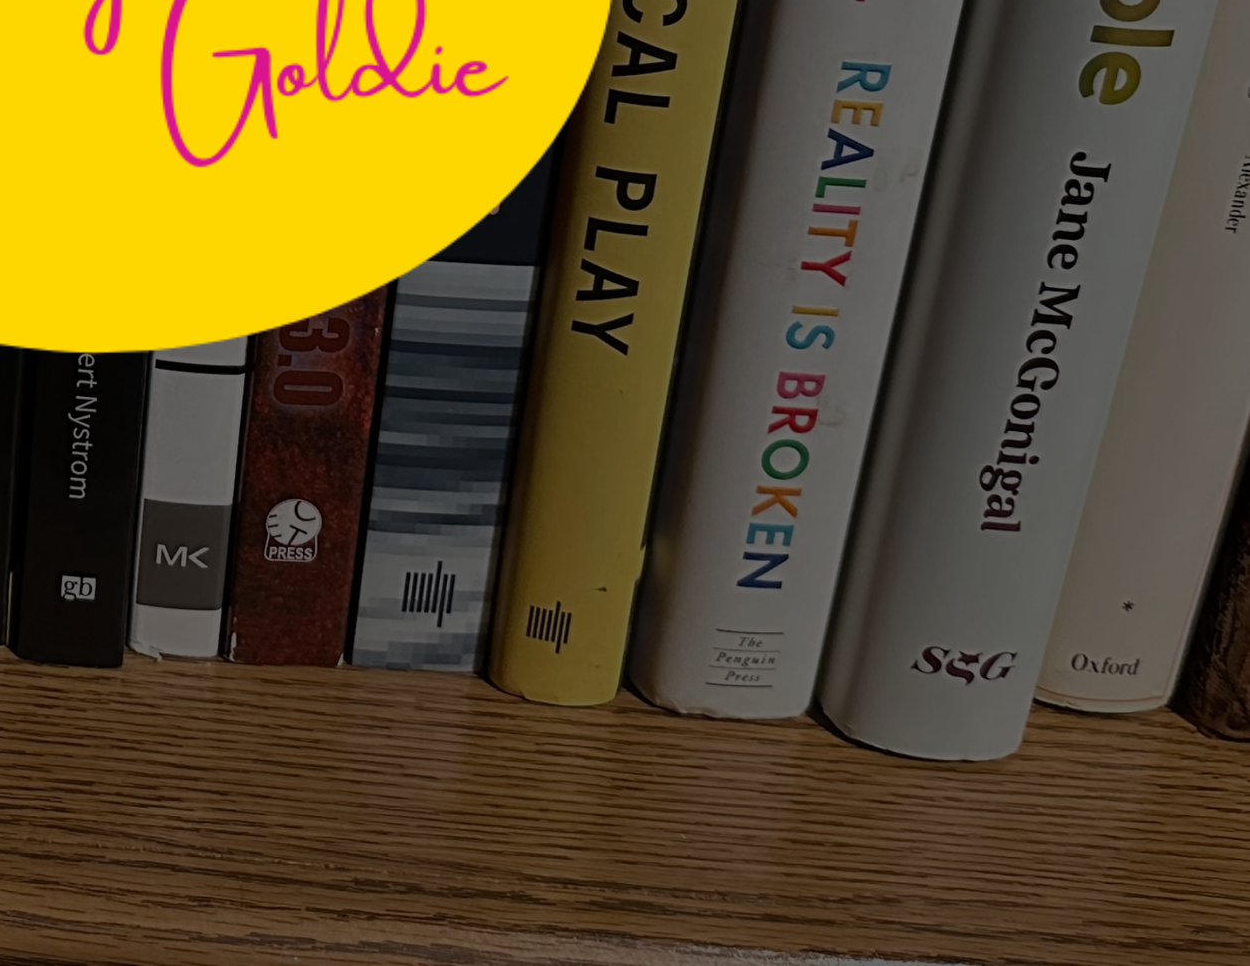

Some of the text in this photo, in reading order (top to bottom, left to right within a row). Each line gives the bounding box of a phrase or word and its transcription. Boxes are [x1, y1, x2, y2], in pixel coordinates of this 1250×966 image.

[800, 60, 892, 287] REALITY
[1047, 151, 1112, 270] Jane
[571, 165, 657, 357] PLAY
[271, 316, 351, 407] 3.0
[786, 304, 840, 351] IS
[67, 394, 98, 501] Nystrom
[979, 281, 1082, 533] McGonigal
[736, 371, 826, 590] BROKEN
[267, 545, 314, 561] PRESS
[715, 650, 777, 667] Penguin
[723, 669, 762, 684] Press
[737, 636, 765, 649] The
[1071, 651, 1140, 676] Oxford
